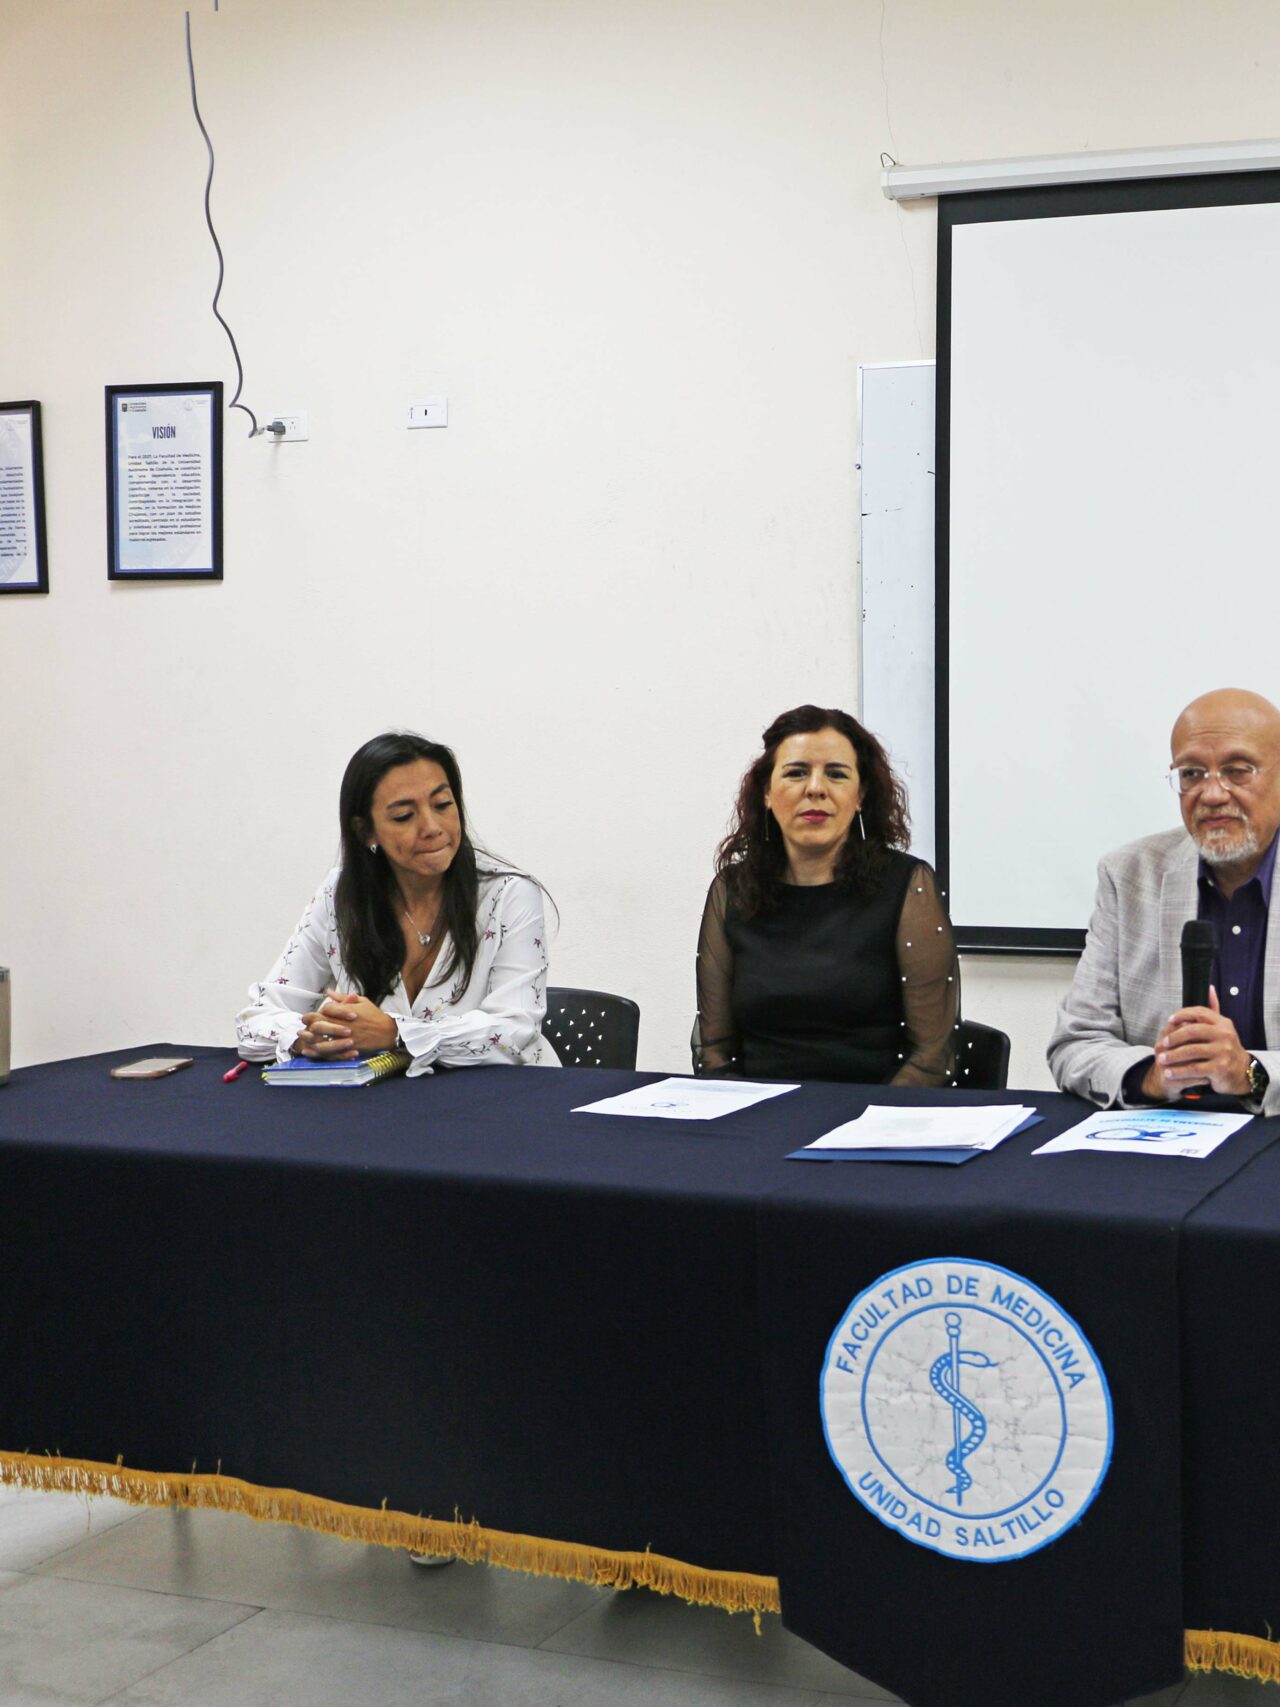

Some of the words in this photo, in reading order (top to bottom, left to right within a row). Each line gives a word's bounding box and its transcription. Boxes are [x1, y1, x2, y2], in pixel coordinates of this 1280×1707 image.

[152, 423, 176, 439] VISIÓN
[835, 1277, 934, 1374] FACULTAD
[946, 1274, 980, 1297] DE
[991, 1284, 1086, 1390] MEDICINA
[858, 1471, 942, 1538] UNIDAD
[955, 1488, 1065, 1547] SALTILLO
